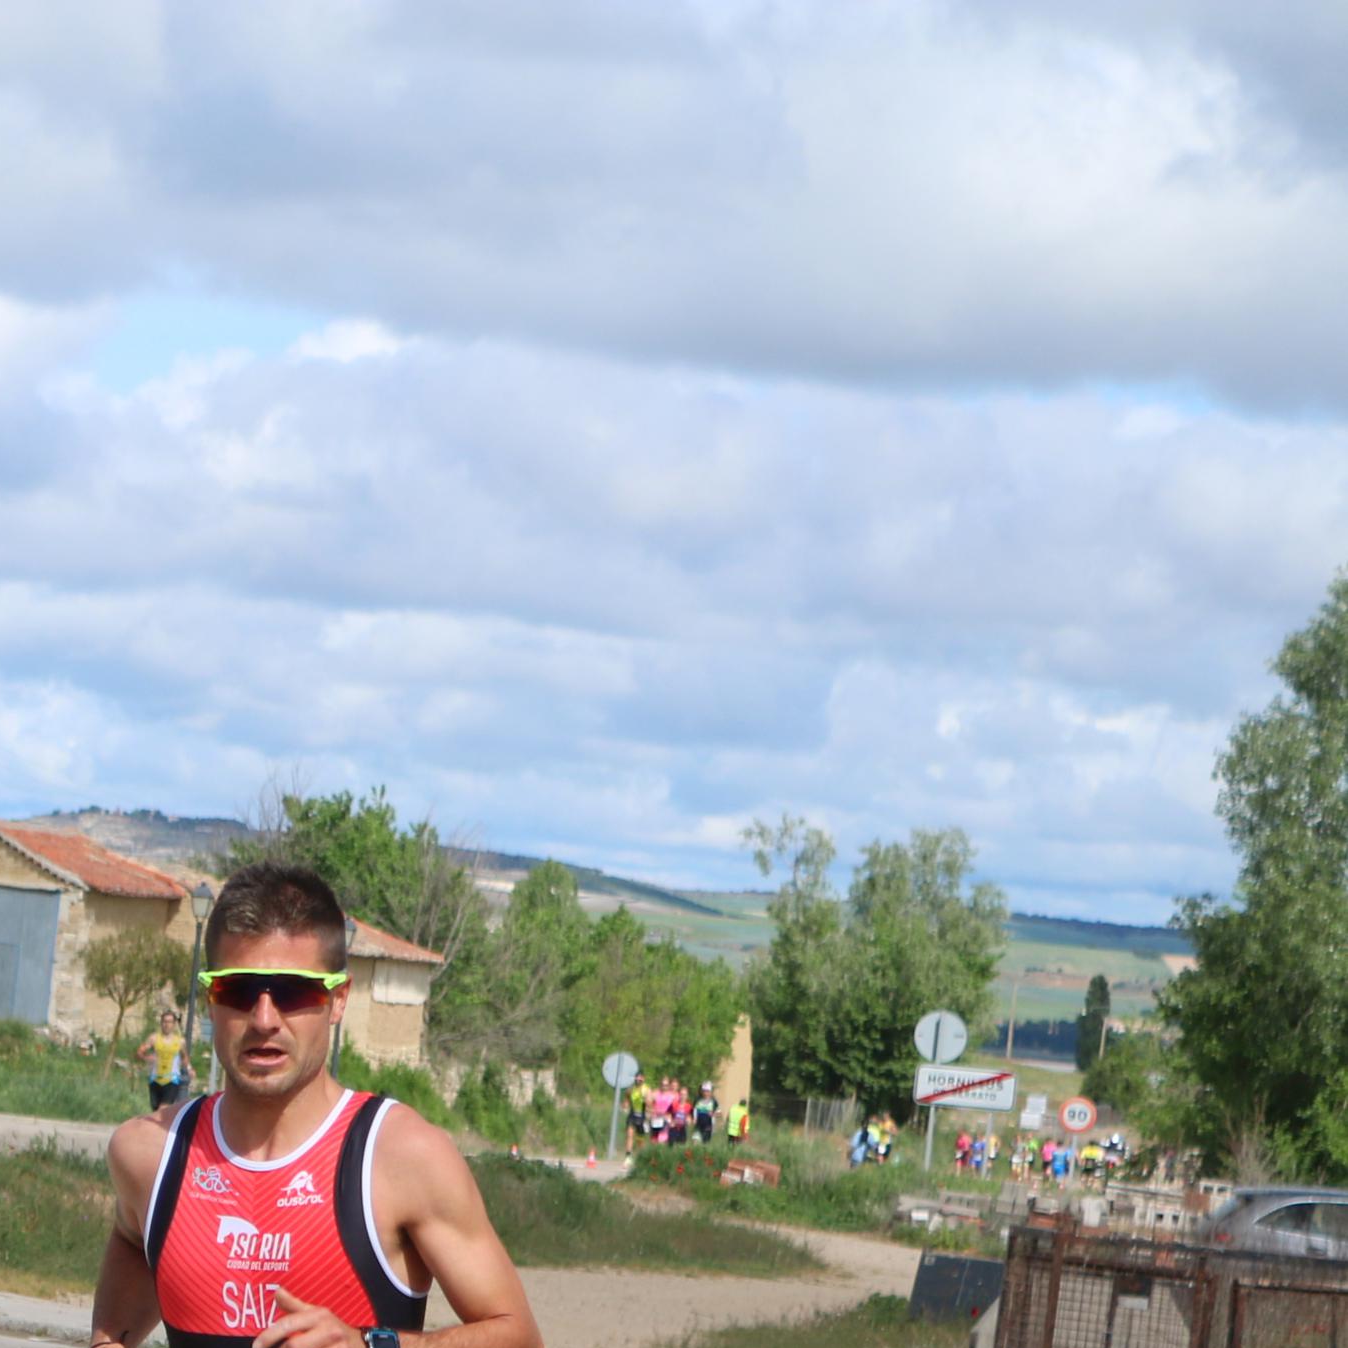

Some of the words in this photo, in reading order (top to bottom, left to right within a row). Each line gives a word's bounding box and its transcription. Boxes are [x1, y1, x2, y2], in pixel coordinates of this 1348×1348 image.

[927, 1074, 1004, 1092] HORNIOS
[1067, 1109, 1088, 1123] 90
[277, 1194, 324, 1208] austral
[229, 1233, 291, 1260] SORIA
